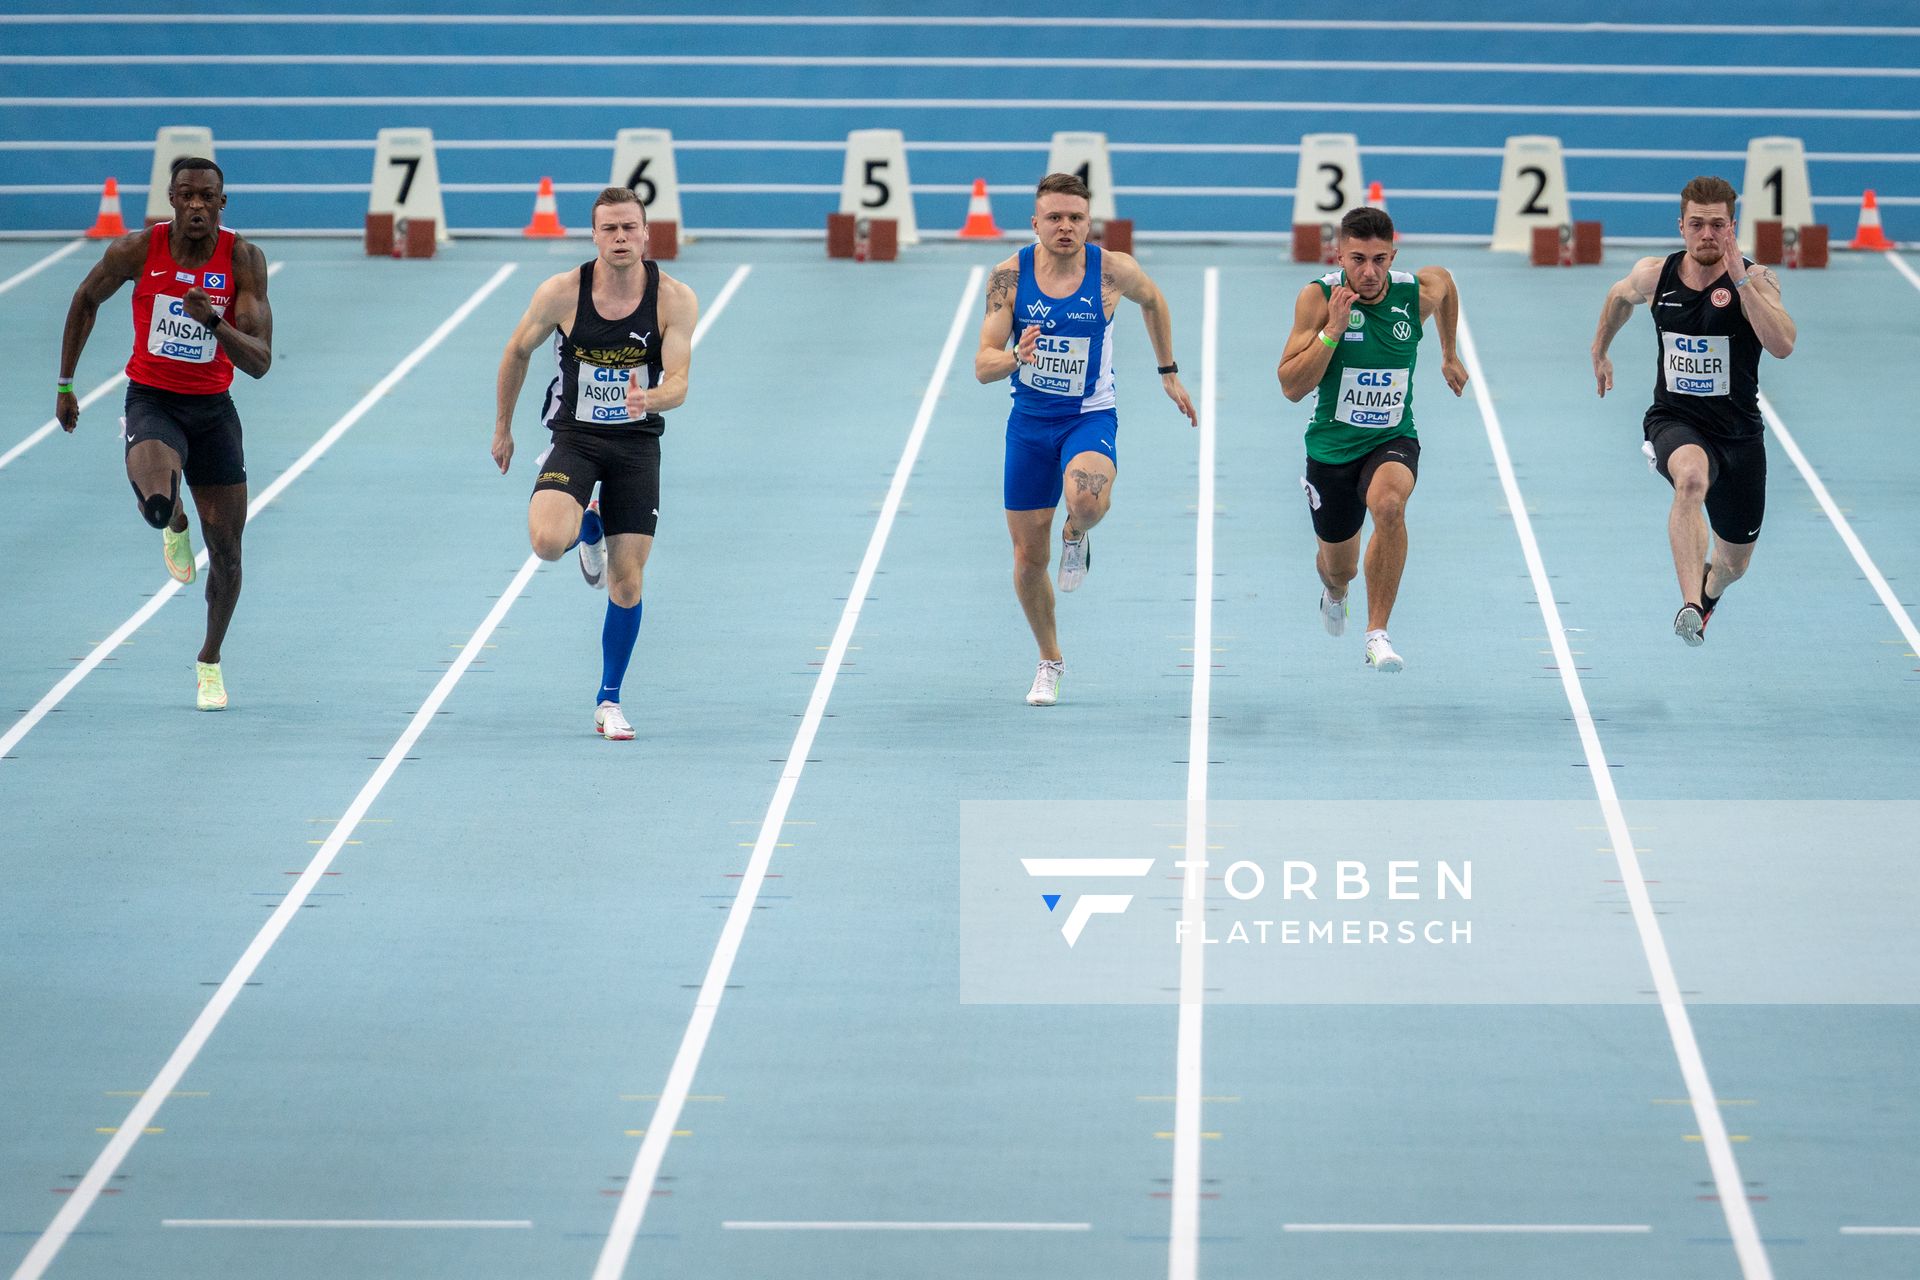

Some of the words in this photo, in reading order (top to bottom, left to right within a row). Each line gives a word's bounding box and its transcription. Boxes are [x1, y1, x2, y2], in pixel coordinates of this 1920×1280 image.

[390, 156, 420, 205] 7
[625, 157, 657, 207] 6
[861, 160, 890, 208] 5
[1316, 163, 1345, 212] 3
[1517, 166, 1549, 215] 2
[1763, 167, 1783, 216] 1
[1066, 312, 1097, 320] VIACTIV
[156, 318, 214, 341] ANSAH
[179, 345, 201, 355] PLAN
[1669, 354, 1723, 375] KEßLER
[1046, 379, 1068, 388] PLAN
[1343, 389, 1402, 408] ALMAS
[1367, 413, 1389, 421] PLAN
